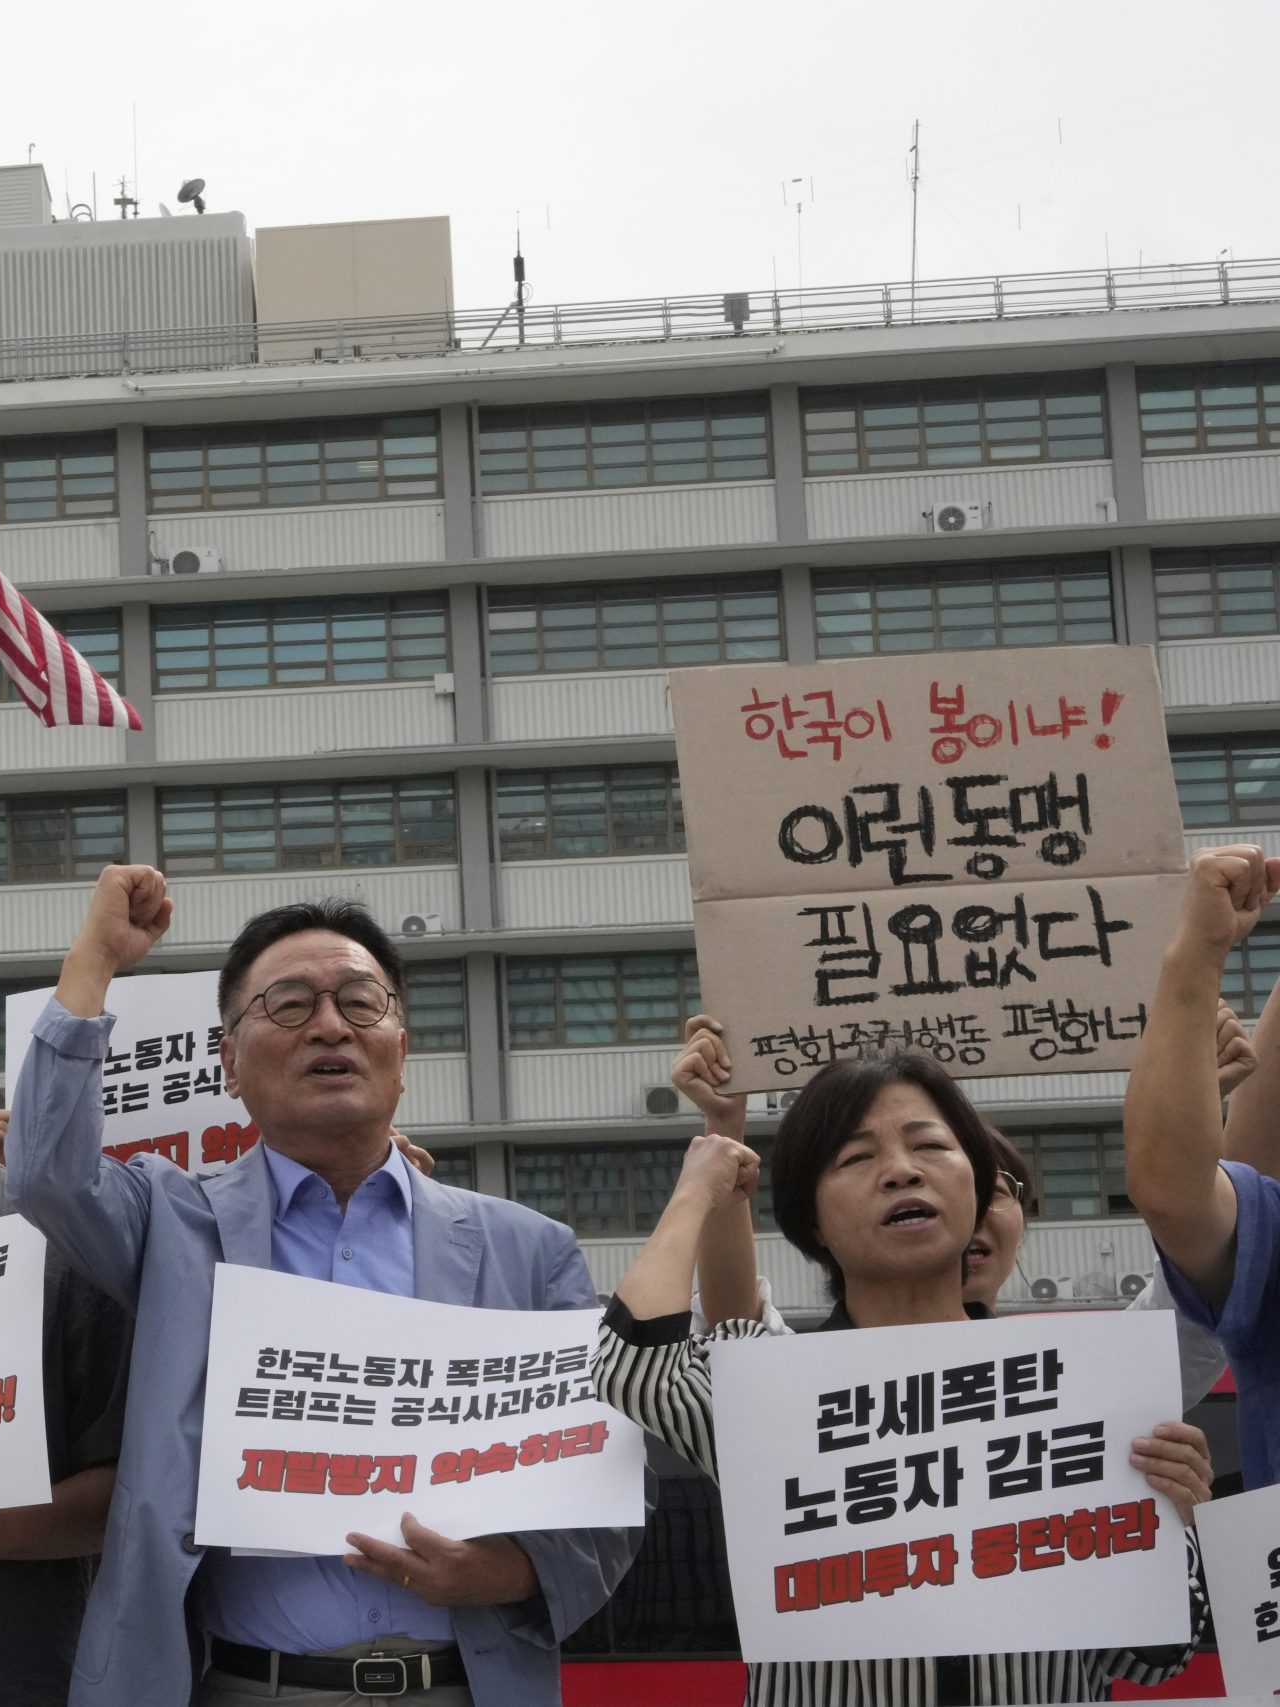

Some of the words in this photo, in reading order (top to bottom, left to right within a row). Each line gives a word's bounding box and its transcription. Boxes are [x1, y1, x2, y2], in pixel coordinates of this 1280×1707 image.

[741, 687, 892, 761] 한국이
[928, 681, 1124, 765] 봉이냐!
[777, 771, 1093, 886] 이런동맹
[797, 885, 1133, 1007] 필요없다
[104, 1031, 196, 1077] 노동자
[162, 1065, 228, 1105] 공식
[235, 1386, 377, 1426] 트럼프는
[254, 1346, 434, 1389] 한국노동자
[445, 1344, 589, 1388] 폭력감금
[817, 1348, 1064, 1454] 관세폭탄
[236, 1447, 417, 1496] 재발방지
[429, 1420, 609, 1486] 약속하라
[783, 1446, 964, 1536] 노동자
[987, 1420, 1106, 1500] 감금
[774, 1534, 958, 1614] 대미투자
[971, 1498, 1160, 1579] 중단하라
